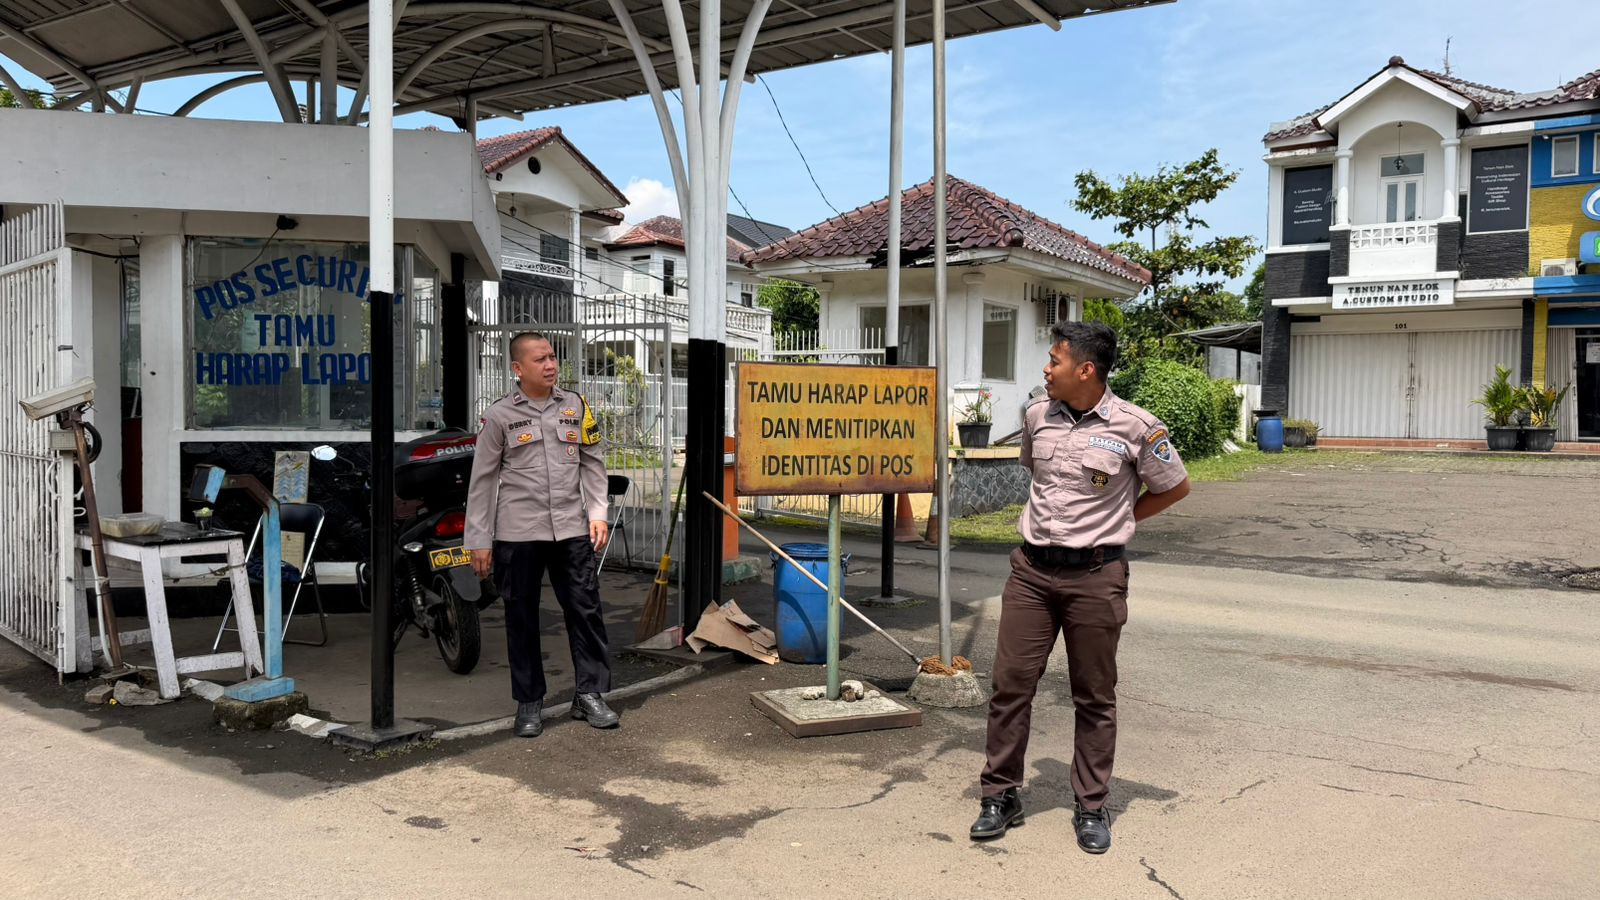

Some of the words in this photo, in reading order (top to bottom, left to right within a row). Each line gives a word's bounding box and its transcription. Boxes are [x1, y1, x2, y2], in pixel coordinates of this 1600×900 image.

[194, 271, 255, 320] POS
[254, 254, 404, 304] SECURI
[1348, 286, 1384, 294] TENUN
[1387, 284, 1409, 292] NAN
[1412, 282, 1440, 291] ELOK
[1398, 294, 1440, 302] STUDIO
[254, 314, 335, 347] TAMU
[196, 352, 290, 386] HARAP
[302, 352, 371, 386] LAPO
[747, 380, 802, 404] TAMU
[808, 382, 869, 405] HARAP
[874, 384, 929, 406] LAPOR
[761, 417, 800, 439] DAN
[806, 417, 915, 440] MENITIPKAN
[761, 454, 851, 476] IDENTITAS
[857, 455, 875, 476] DI
